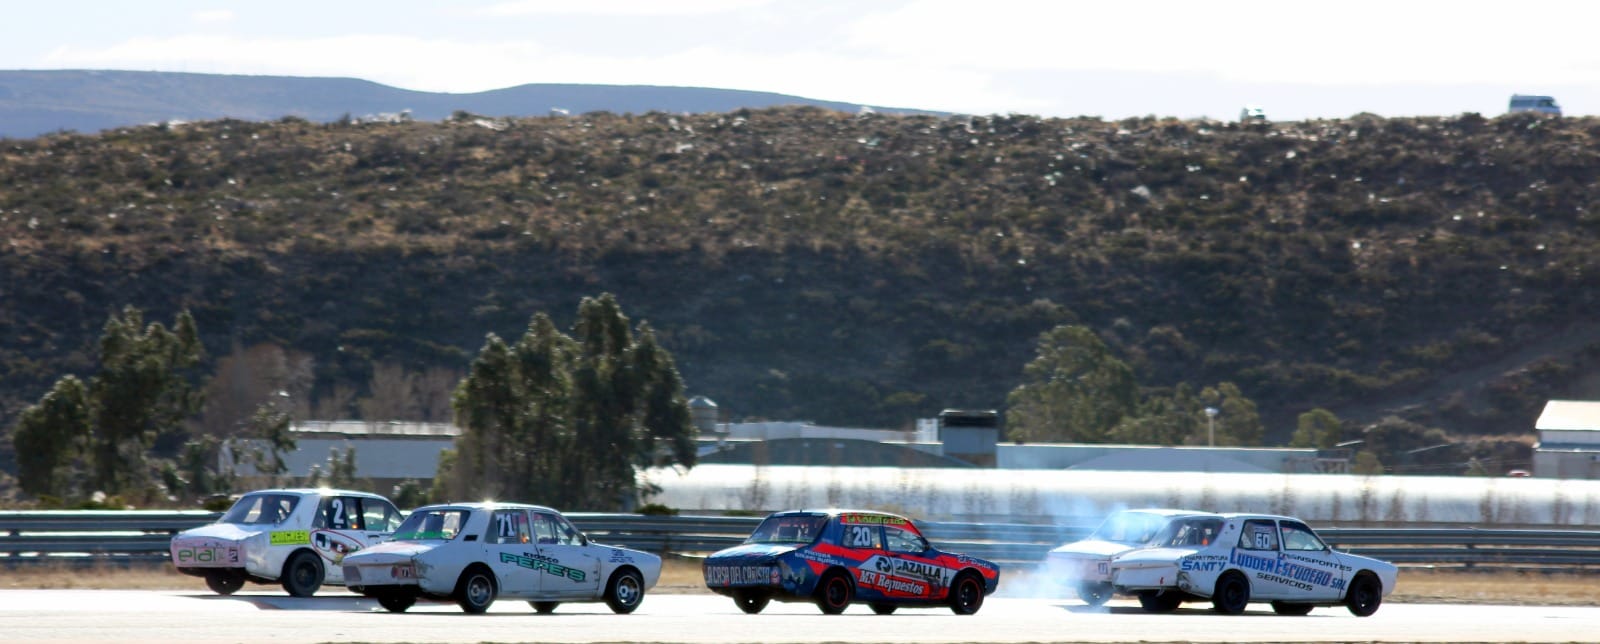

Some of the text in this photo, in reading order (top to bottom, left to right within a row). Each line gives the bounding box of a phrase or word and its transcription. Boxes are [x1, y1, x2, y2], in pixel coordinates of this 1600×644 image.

[332, 499, 344, 525] 2
[496, 512, 516, 537] 71
[852, 527, 872, 547] 20
[1255, 533, 1270, 549] 60
[500, 552, 587, 583] PEPE'S
[523, 551, 560, 564] KIOSCO
[1181, 560, 1227, 573] SANTY
[730, 566, 742, 584] DEL
[1275, 556, 1333, 587] ESCUDERO
[878, 573, 925, 596] Repuestos
[1256, 572, 1314, 592] SERVICIOS
